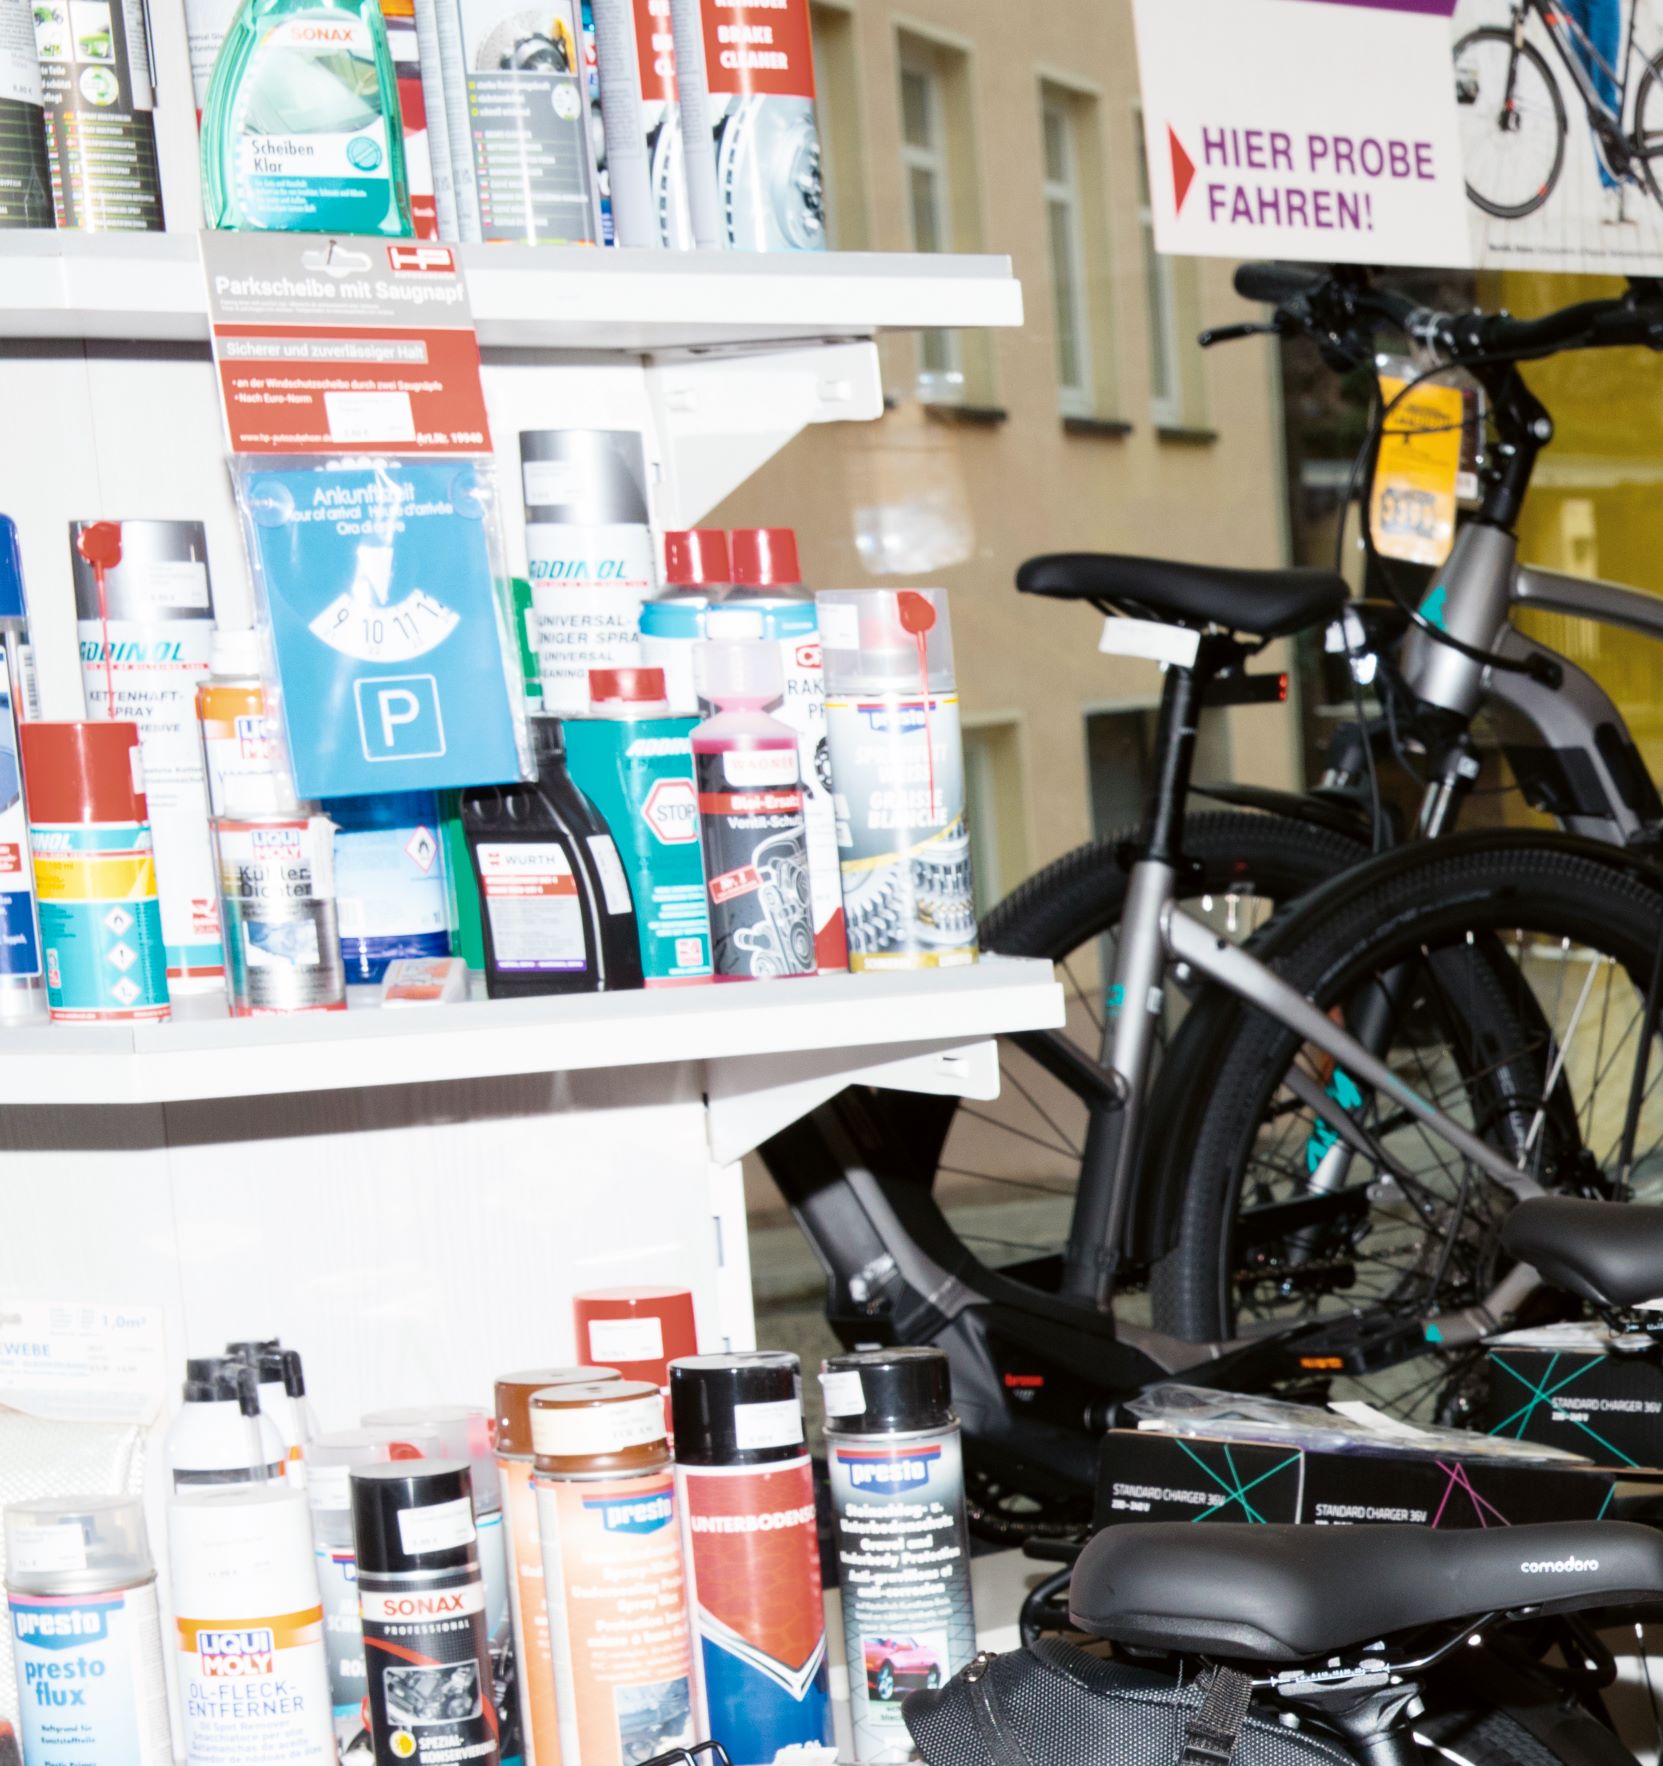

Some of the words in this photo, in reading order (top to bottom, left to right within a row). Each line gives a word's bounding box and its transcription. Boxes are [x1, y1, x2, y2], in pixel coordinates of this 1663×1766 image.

[291, 28, 353, 42] SONAX
[718, 25, 773, 44] BRAKE
[720, 52, 789, 70] CLEANER
[251, 140, 314, 156] Scheiben
[1201, 126, 1295, 171] HIER
[1308, 135, 1436, 183] PROBE
[254, 158, 283, 173] Klar
[1207, 187, 1374, 231] FAHREN!
[215, 275, 336, 298] Parkscheibe
[341, 281, 371, 300] mit
[376, 282, 465, 305] Saugnapf
[226, 342, 281, 358] Sicherer
[284, 343, 308, 358] und
[398, 346, 425, 360] Halt
[529, 559, 630, 581] ADDINOL
[362, 617, 384, 645] 10
[594, 630, 640, 645] SPRA
[79, 641, 186, 662] ADDINOL
[377, 688, 420, 748] P
[656, 804, 697, 822] STOP
[1552, 1396, 1600, 1411] STANDARD
[1600, 1399, 1644, 1413] CHARGER
[1644, 1401, 1662, 1414] 36V
[853, 1460, 925, 1485] presto
[1112, 1482, 1161, 1500] STANDARD
[1163, 1488, 1207, 1505] CHARGER
[1207, 1491, 1225, 1507] 36V
[1315, 1503, 1355, 1520] STANDARD
[1356, 1505, 1402, 1522] CHARGER
[904, 1533, 934, 1551] and
[1519, 1554, 1600, 1576] comodoro
[382, 1591, 466, 1617] SONAX
[16, 1609, 102, 1638] presto
[383, 1619, 471, 1635] PROFESSIONAL
[199, 1632, 272, 1655] LIQUI
[24, 1656, 106, 1685] presto
[202, 1653, 274, 1677] MOLY
[35, 1680, 86, 1707] flux
[188, 1695, 305, 1718] ENTFERNER
